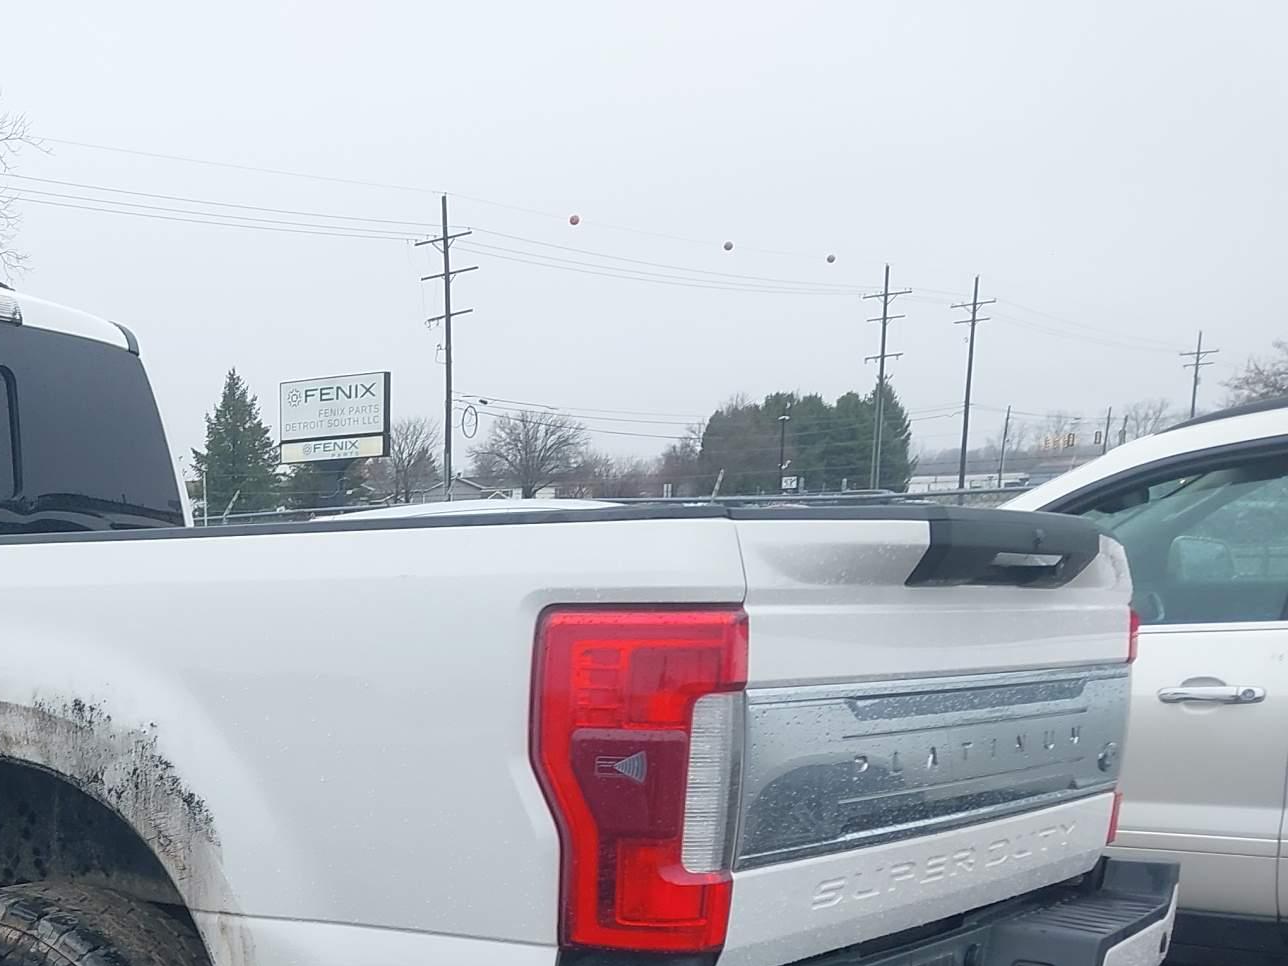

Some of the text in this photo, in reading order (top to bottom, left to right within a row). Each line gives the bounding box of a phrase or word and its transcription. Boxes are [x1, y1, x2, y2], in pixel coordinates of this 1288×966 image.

[304, 382, 377, 403] FENIX
[318, 404, 380, 418] FENIX PARTS
[286, 415, 380, 433] DETROIT SOUTH LLC
[313, 439, 360, 453] FENIX
[853, 725, 1082, 774] PLATINUM
[811, 821, 1078, 911] SUPER DUTY
